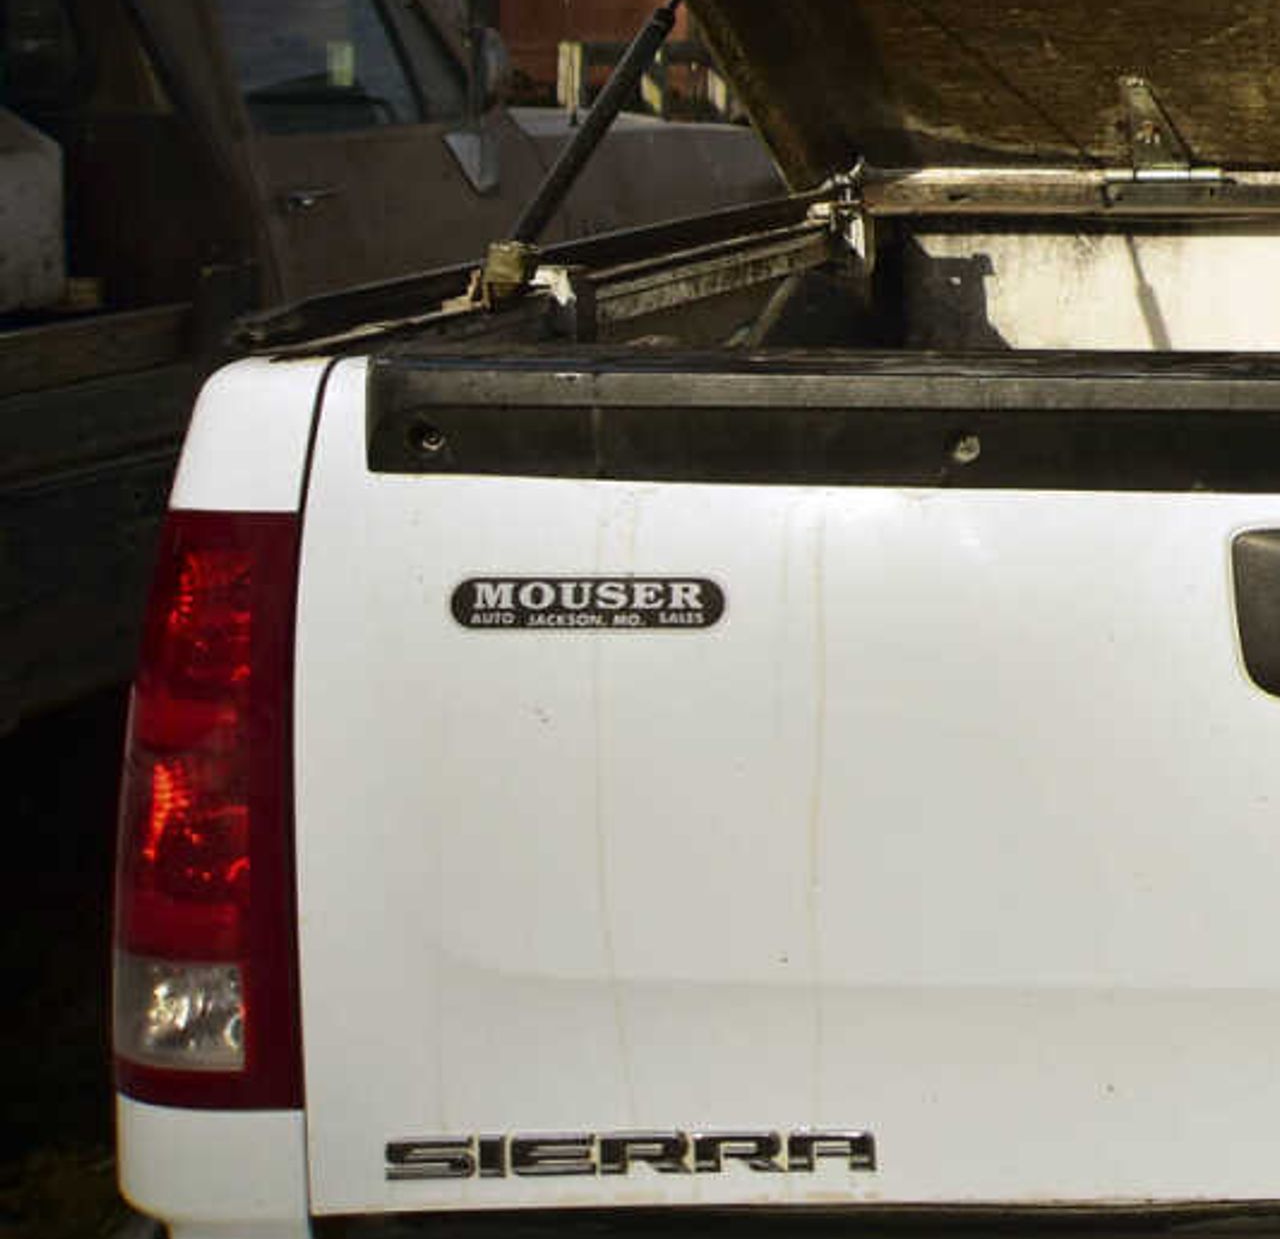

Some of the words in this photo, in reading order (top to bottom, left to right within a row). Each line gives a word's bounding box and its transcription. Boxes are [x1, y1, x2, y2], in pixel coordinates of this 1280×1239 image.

[473, 581, 703, 609] MOUSER
[470, 613, 516, 625] AUTO
[659, 612, 705, 625] SALES
[385, 1130, 876, 1180] SIERRA
